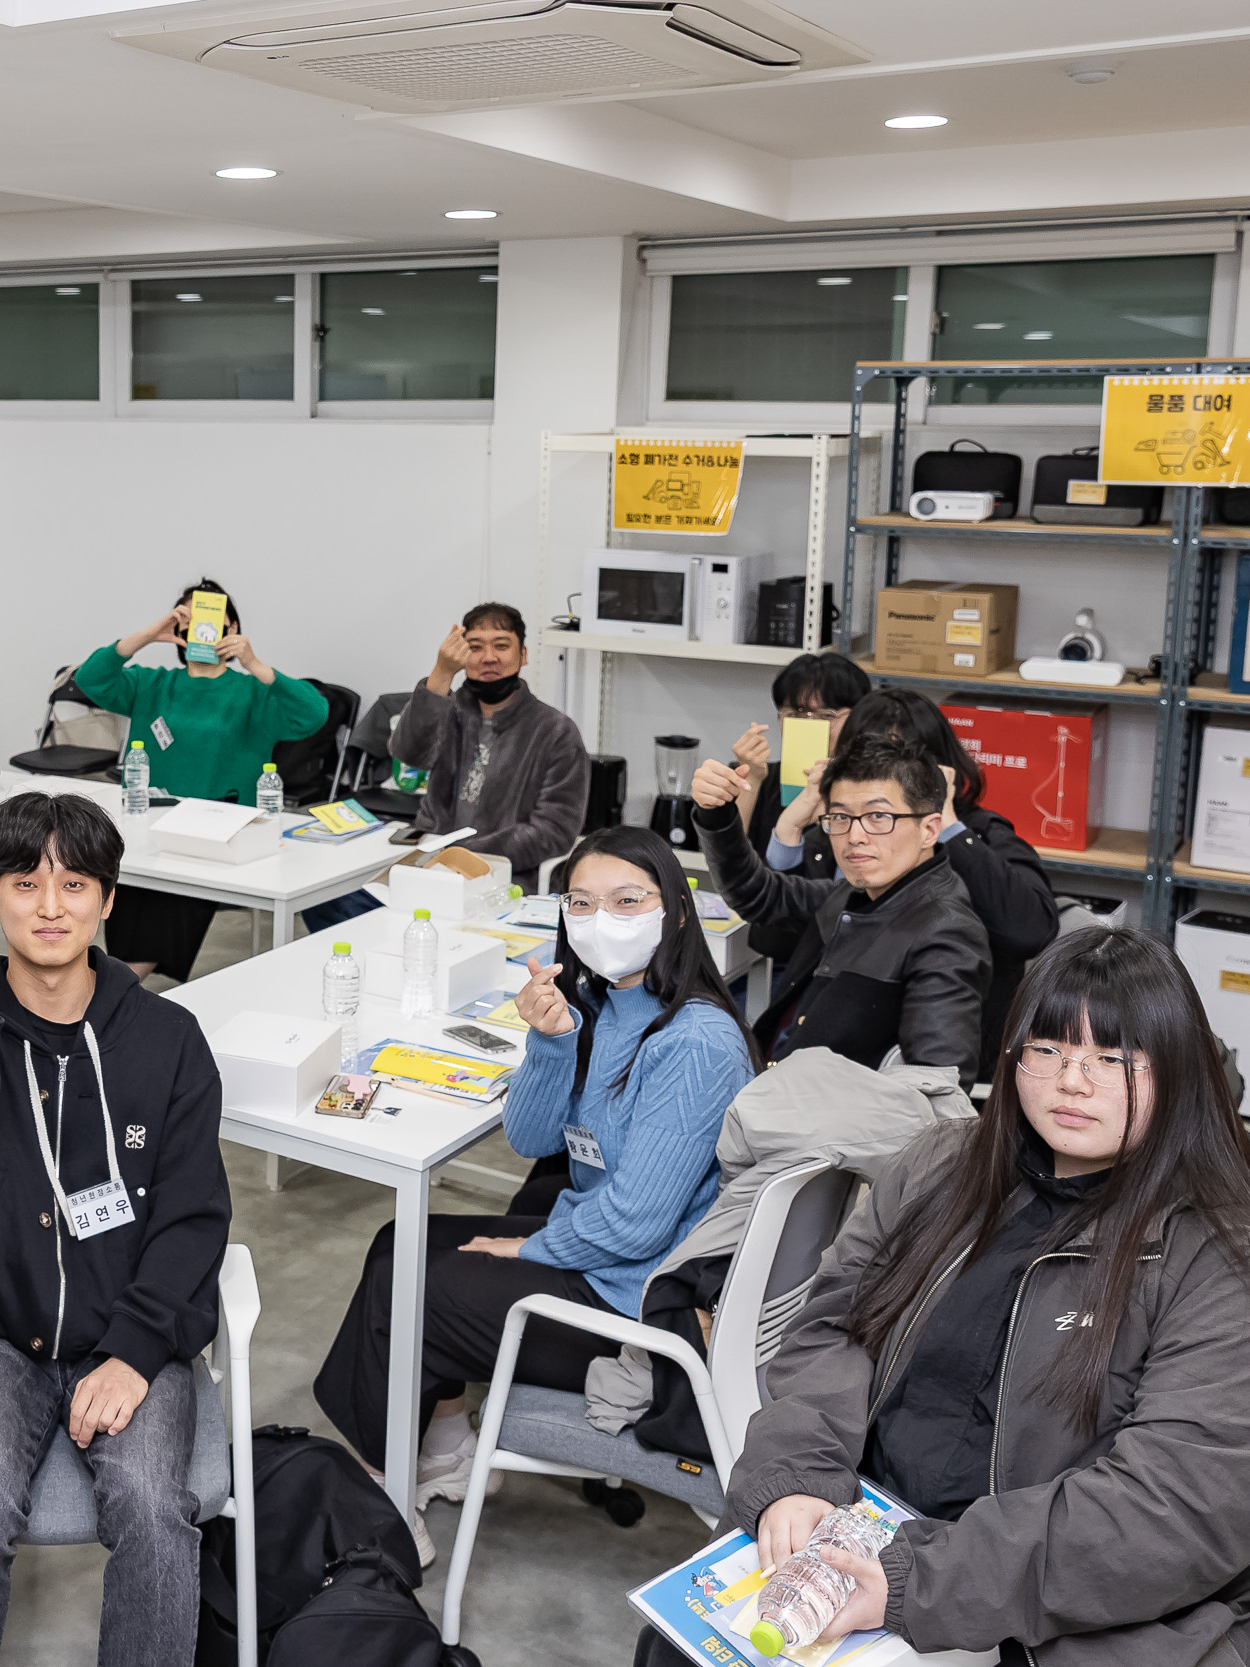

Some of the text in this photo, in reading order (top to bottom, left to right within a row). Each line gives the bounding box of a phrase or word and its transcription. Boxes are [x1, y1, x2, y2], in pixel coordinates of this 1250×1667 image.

[1146, 394, 1232, 413] 물품 대여
[617, 453, 640, 466] 소형
[699, 1634, 736, 1664] 타워
